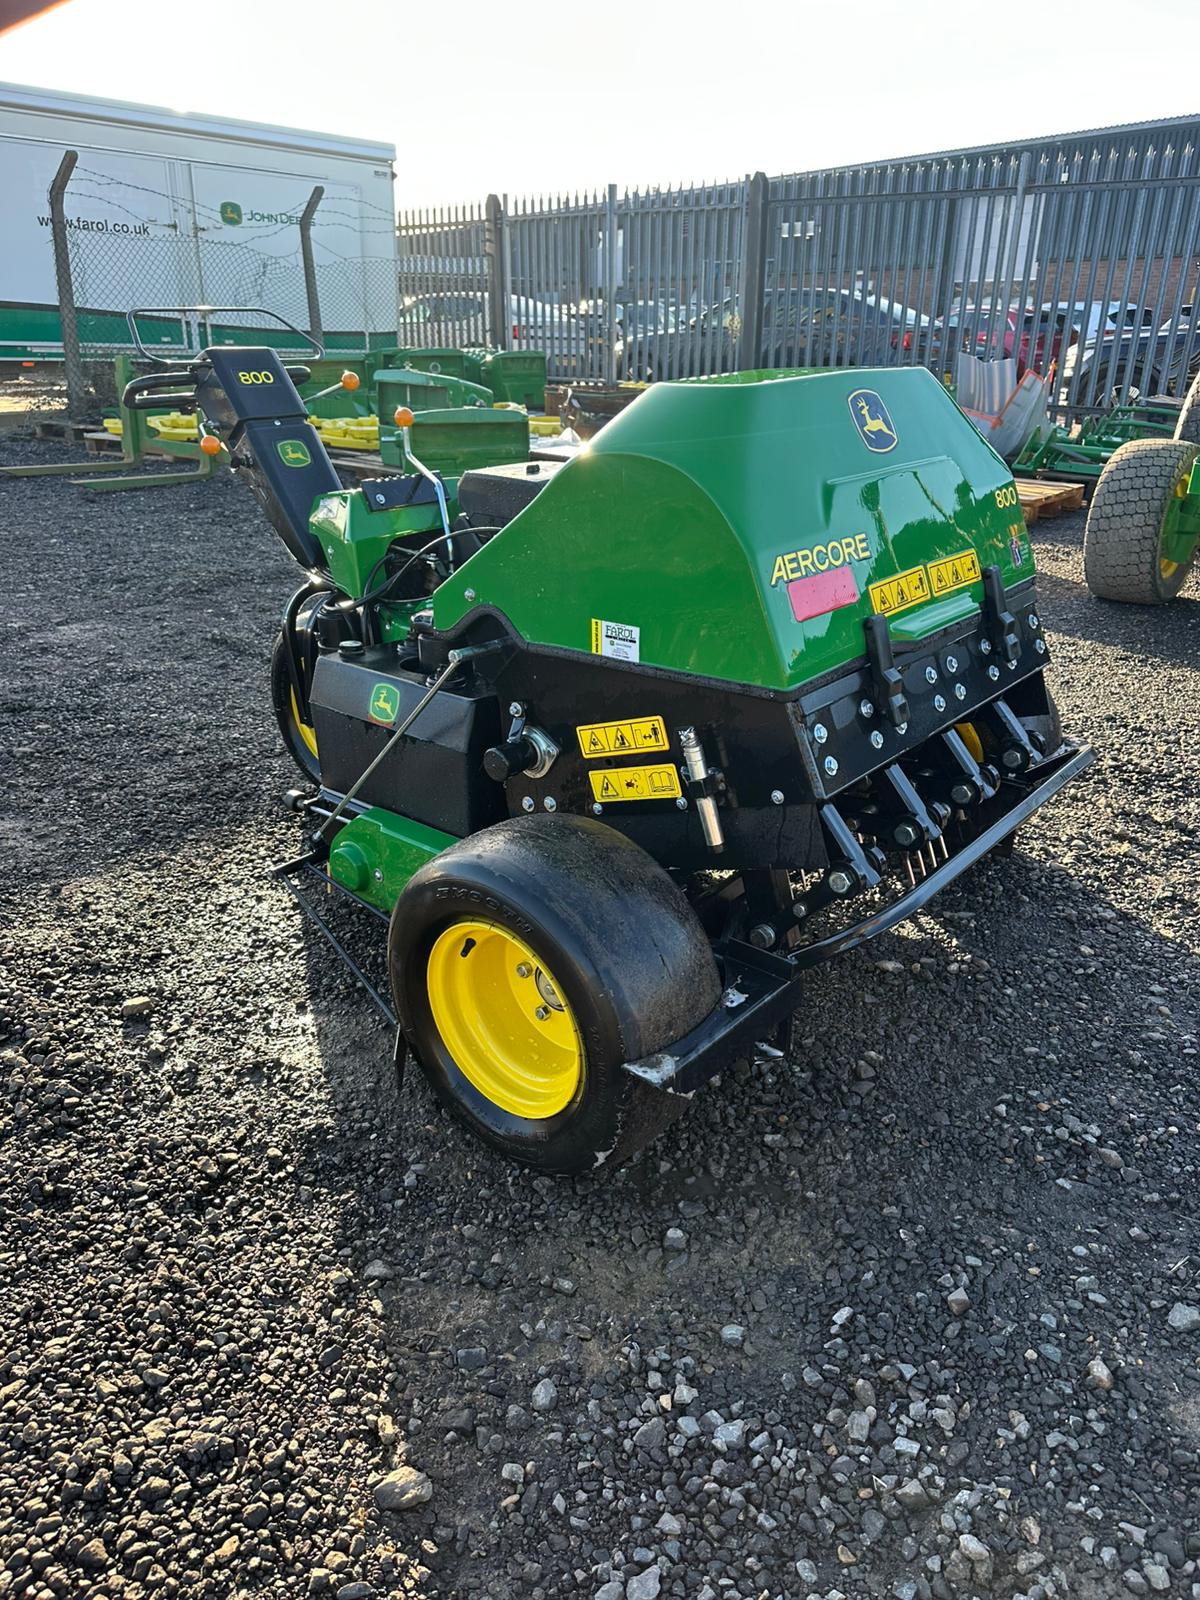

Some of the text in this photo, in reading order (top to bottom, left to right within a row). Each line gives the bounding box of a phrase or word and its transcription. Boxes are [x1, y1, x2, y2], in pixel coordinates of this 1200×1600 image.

[37, 216, 150, 236] ww.farol.co.uk
[247, 210, 316, 227] JOHN DEEE
[238, 371, 274, 385] 800
[995, 486, 1017, 509] 800
[770, 533, 871, 586] AERCORE
[605, 624, 636, 640] FAROL
